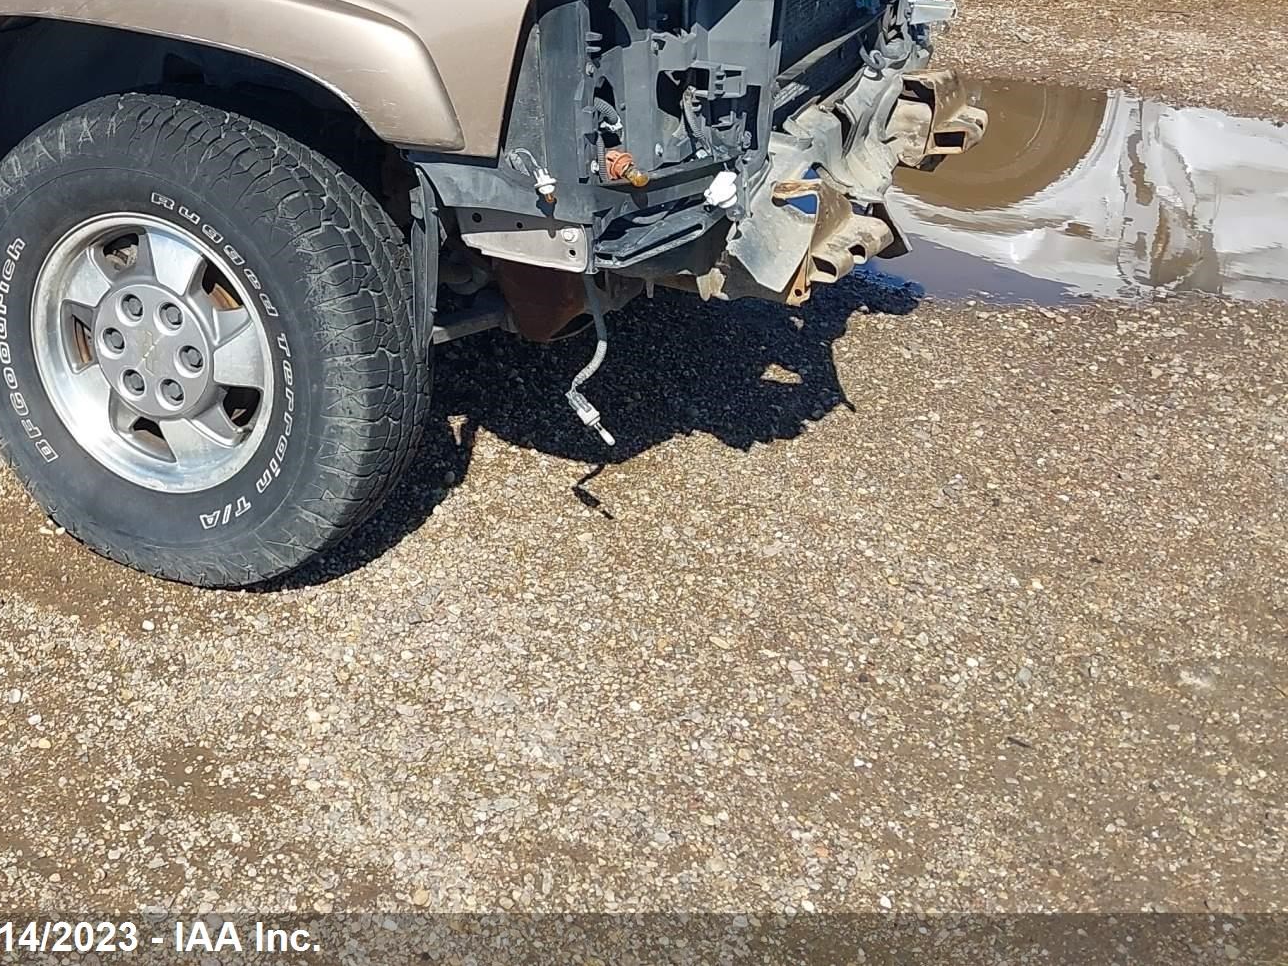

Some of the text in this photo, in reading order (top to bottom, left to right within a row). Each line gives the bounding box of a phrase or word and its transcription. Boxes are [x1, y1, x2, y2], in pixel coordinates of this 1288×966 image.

[150, 191, 280, 318] Rugged
[255, 331, 296, 495] Terrain
[199, 494, 254, 531] T/A
